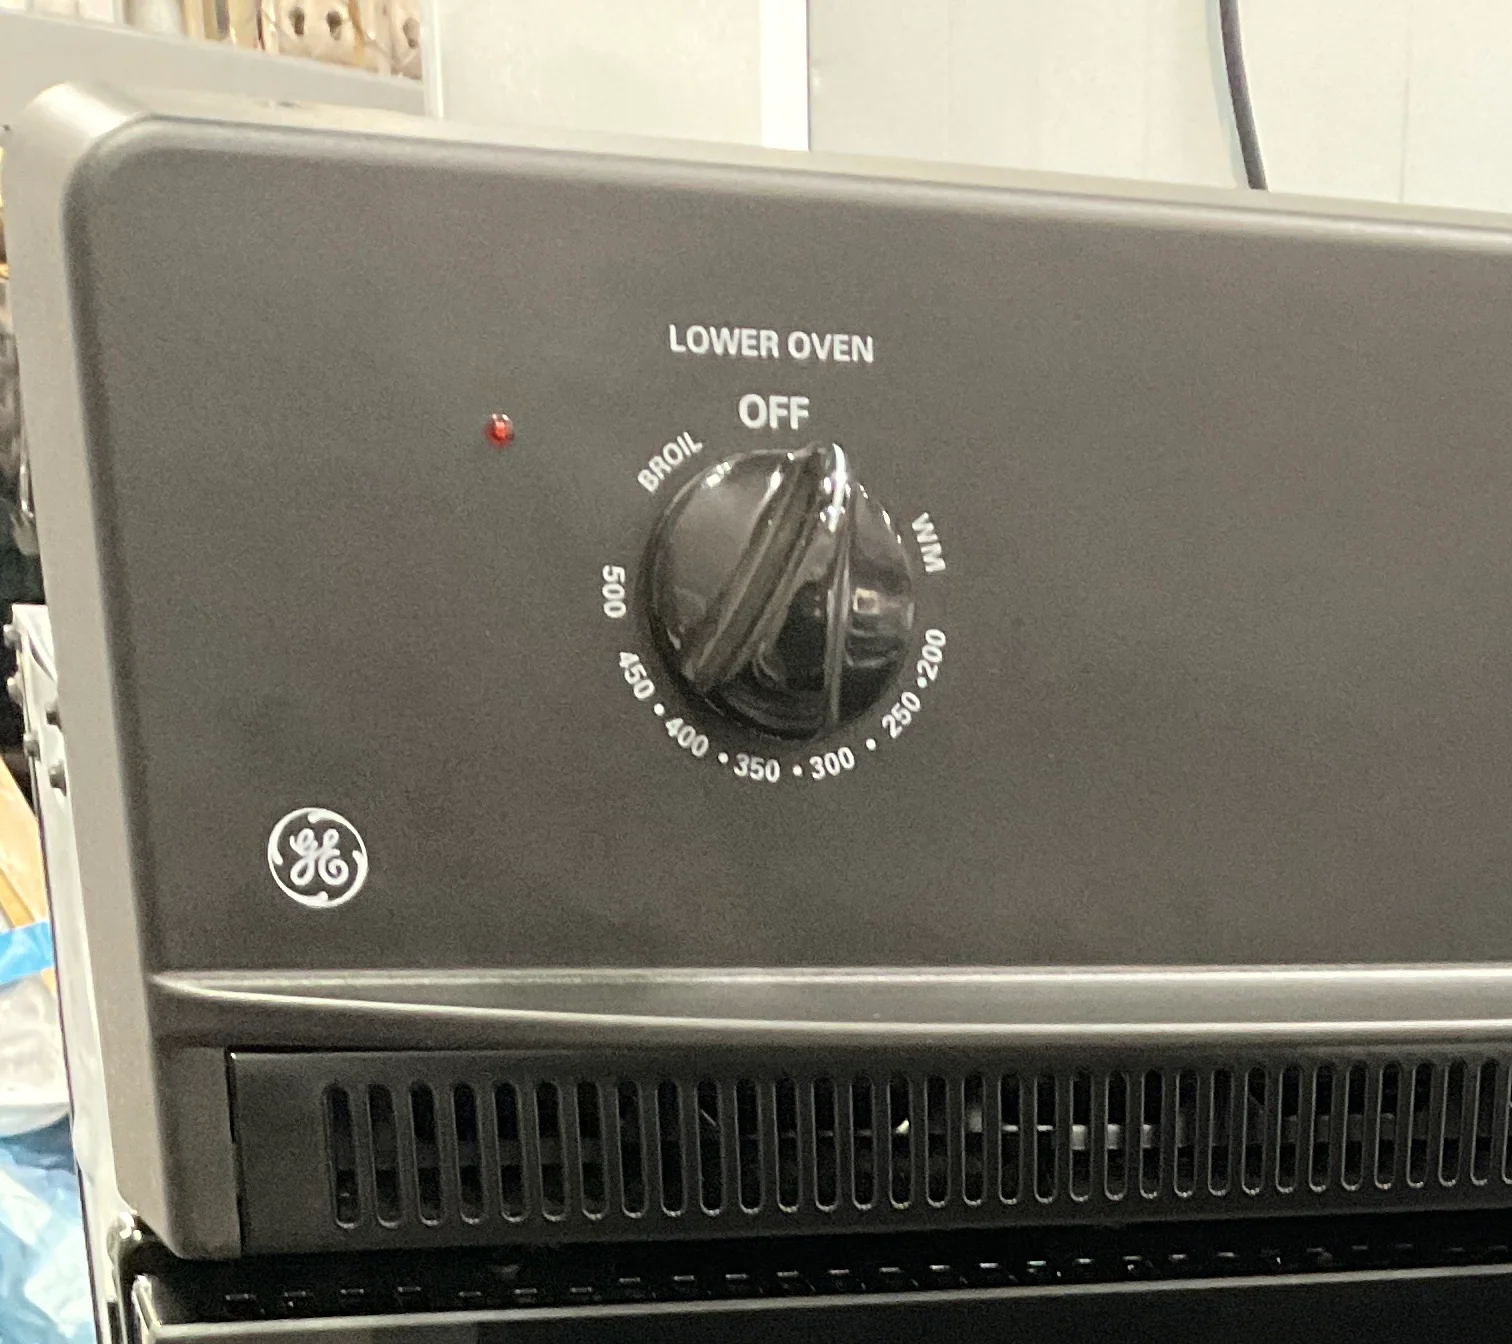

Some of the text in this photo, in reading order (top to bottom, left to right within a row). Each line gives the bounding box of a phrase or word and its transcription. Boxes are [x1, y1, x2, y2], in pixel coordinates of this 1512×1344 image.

[669, 324, 875, 363] LOWER OVEN
[738, 393, 810, 430] OFF
[637, 431, 703, 493] BROIL
[911, 512, 947, 573] WM
[602, 565, 627, 618] 500
[619, 650, 656, 701] 450
[918, 628, 947, 682] 200
[665, 717, 710, 759] 400
[882, 692, 923, 740] 250
[733, 753, 781, 783] 350
[809, 747, 855, 781] 300
